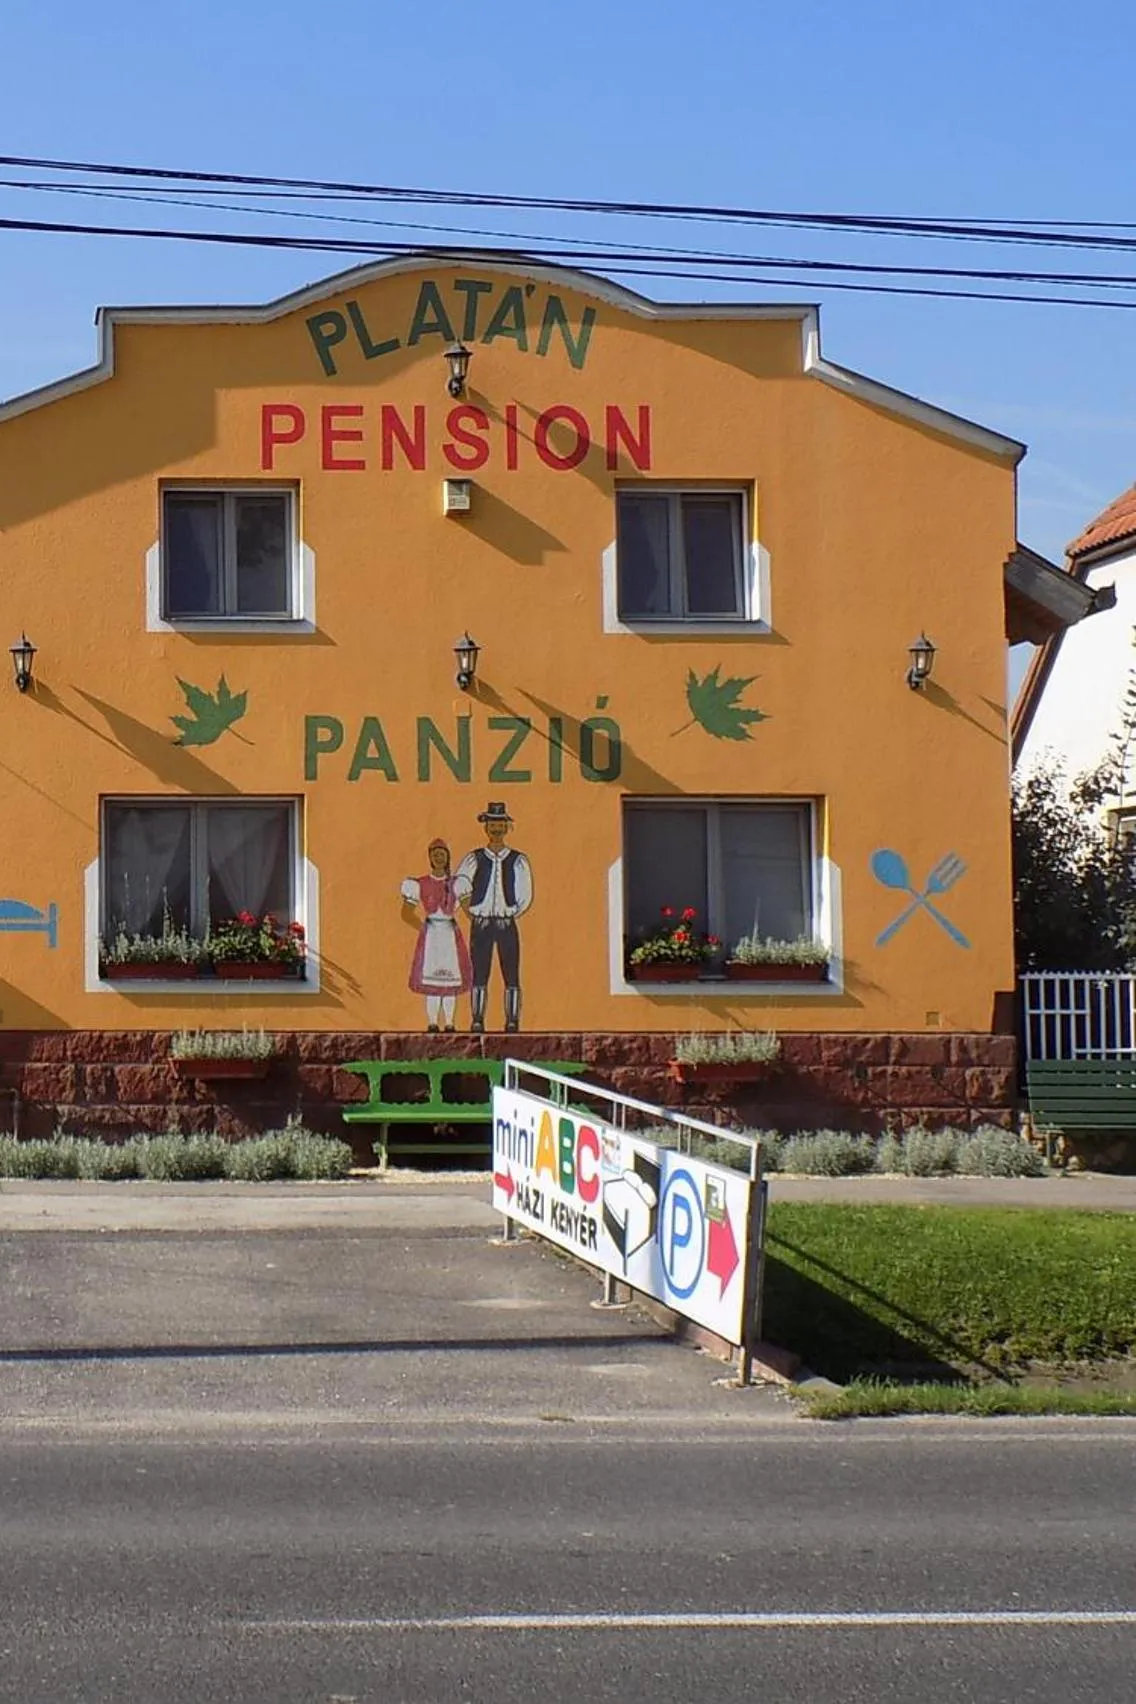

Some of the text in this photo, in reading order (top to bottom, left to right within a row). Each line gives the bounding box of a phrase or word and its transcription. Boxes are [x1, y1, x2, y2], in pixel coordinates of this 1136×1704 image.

[306, 279, 596, 377] PLATÁN
[261, 404, 650, 471] PENSION
[304, 695, 622, 782] PANZIÓ
[516, 1175, 598, 1252] HÁZI KENYÉR
